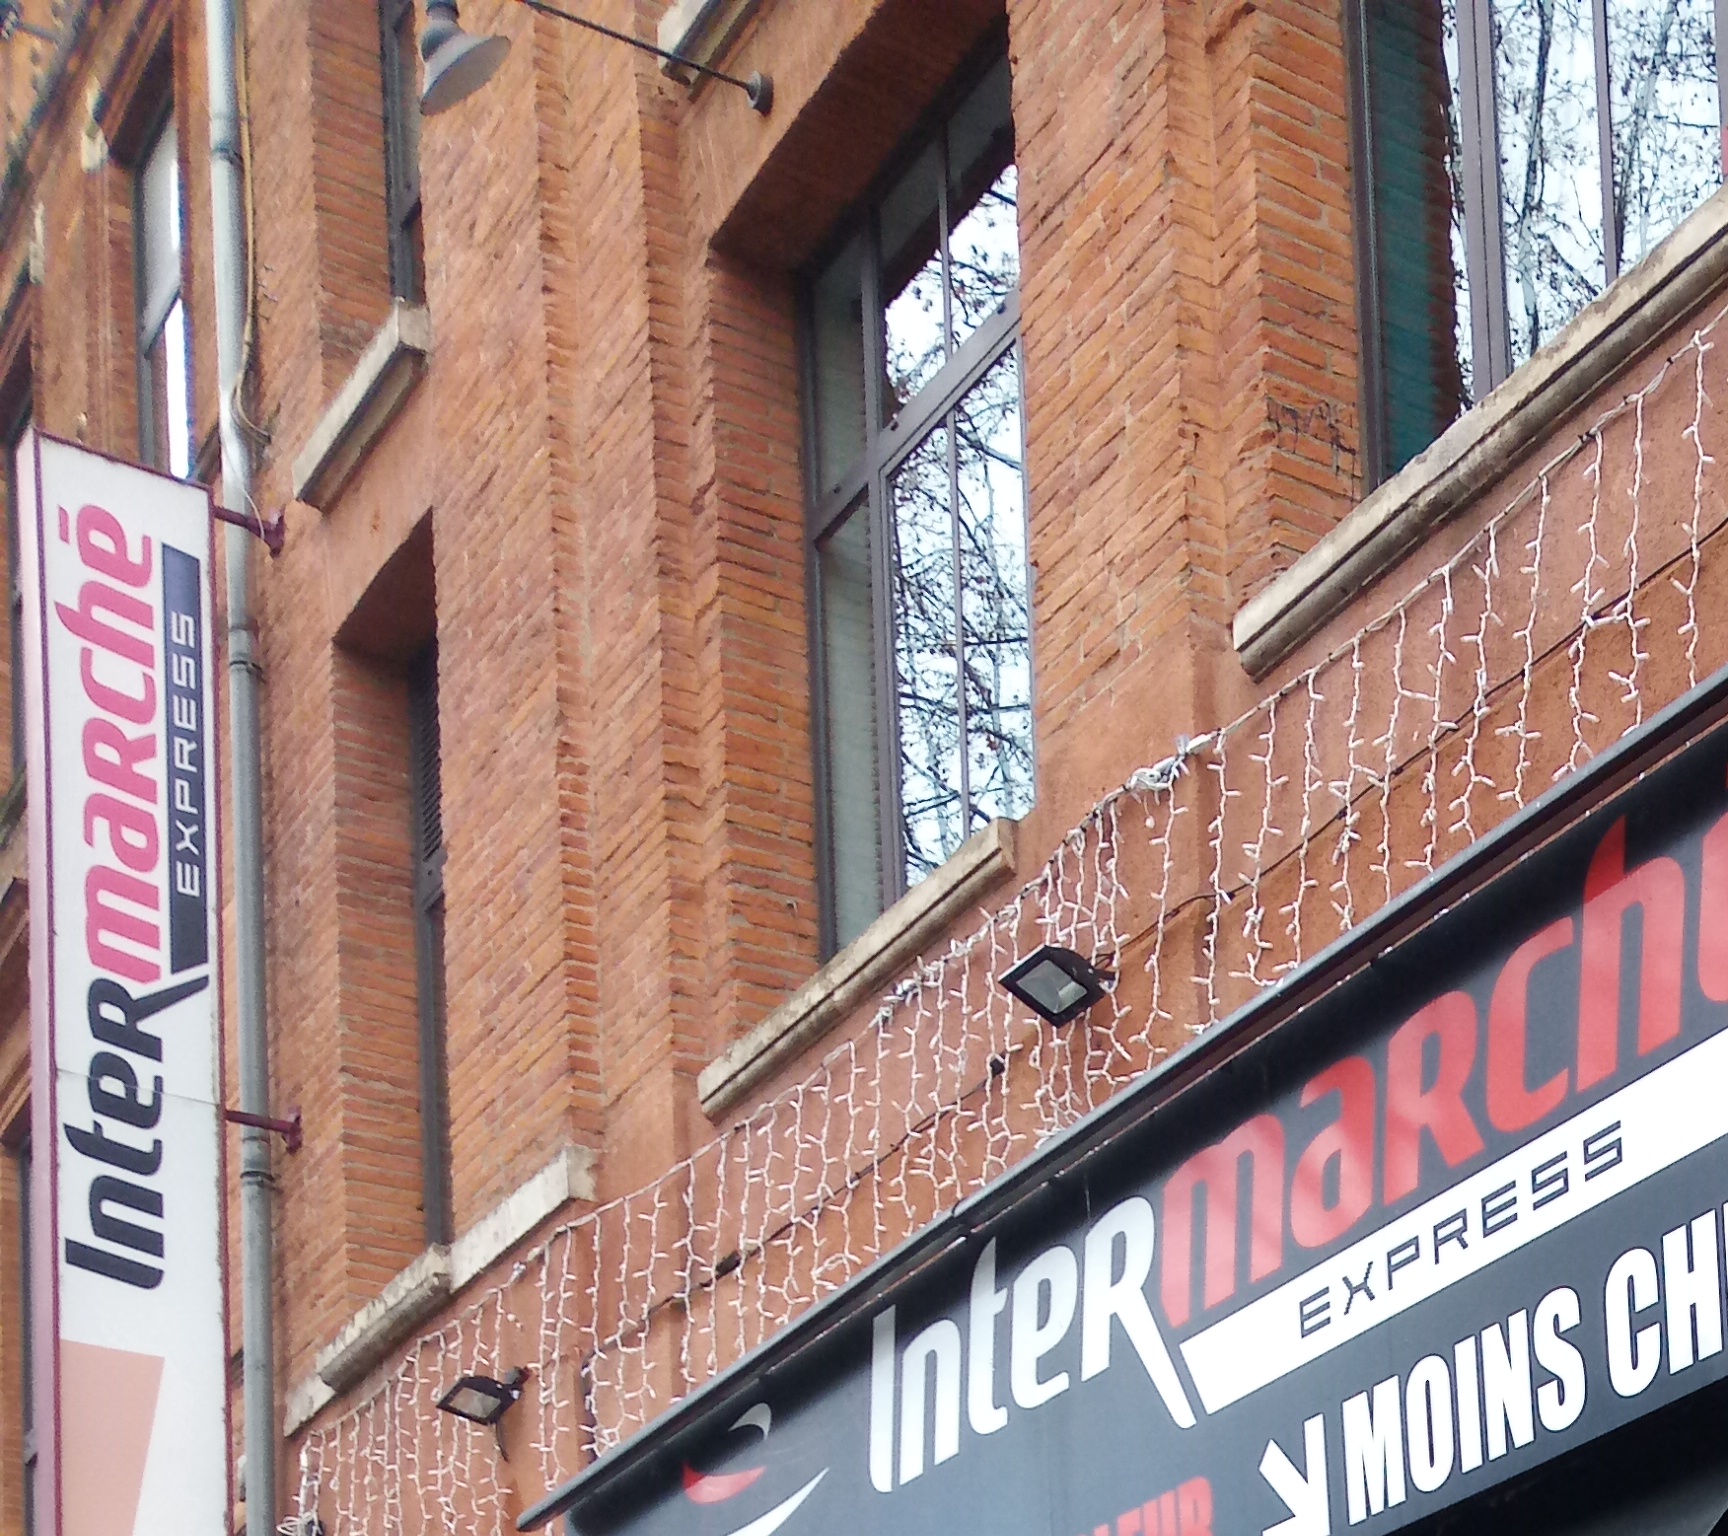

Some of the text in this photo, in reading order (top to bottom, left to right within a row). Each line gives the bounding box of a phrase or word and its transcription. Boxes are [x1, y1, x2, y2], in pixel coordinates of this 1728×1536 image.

[174, 609, 198, 900] EXPRESS
[1298, 1120, 1624, 1338] EXPRESS
[1345, 1284, 1588, 1528] MOINS
